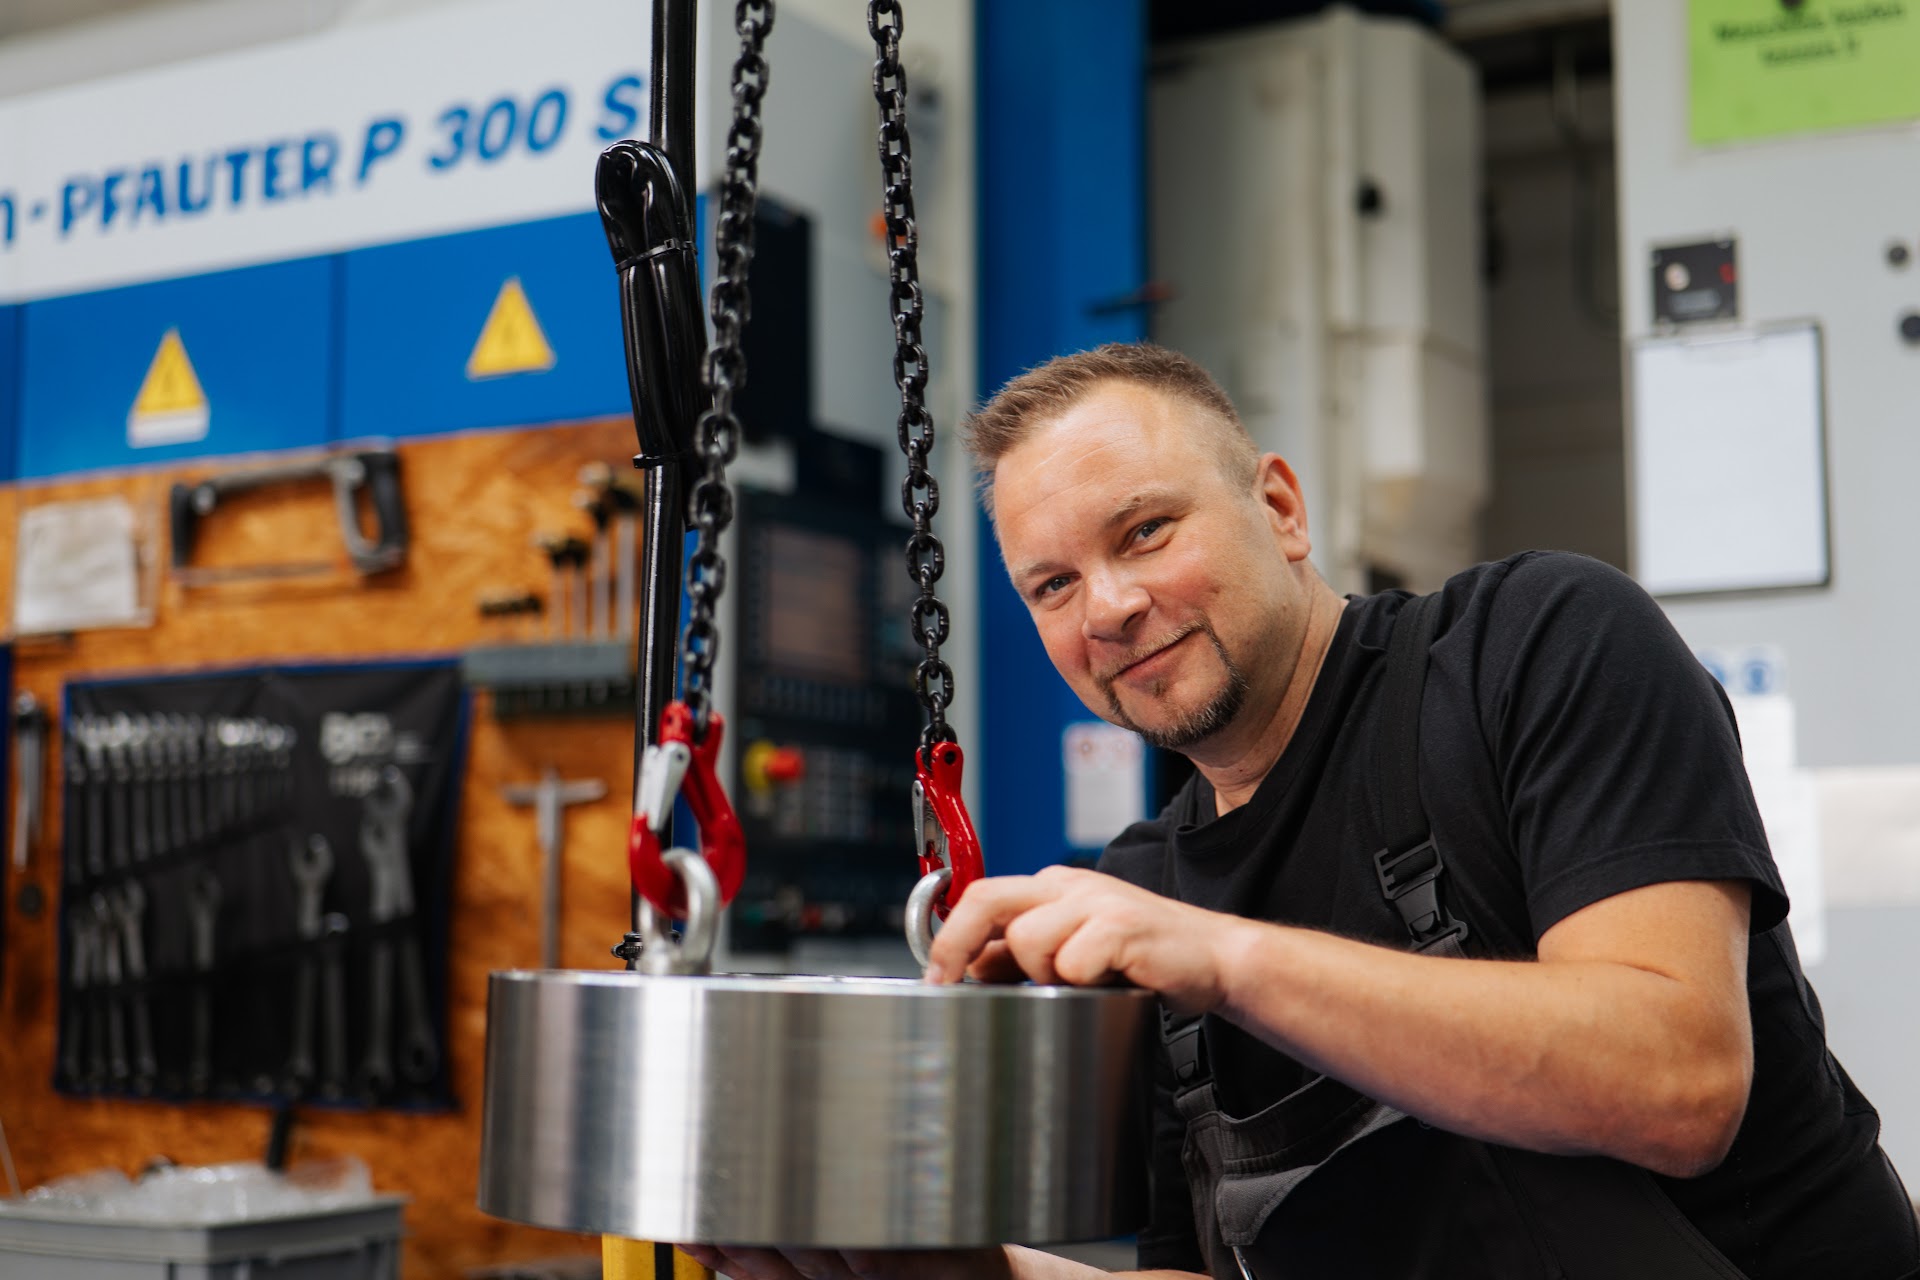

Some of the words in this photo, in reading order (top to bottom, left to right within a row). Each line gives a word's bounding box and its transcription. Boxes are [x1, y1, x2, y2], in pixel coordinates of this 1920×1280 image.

[354, 116, 409, 185] P
[426, 86, 571, 171] 300
[595, 72, 646, 144] S
